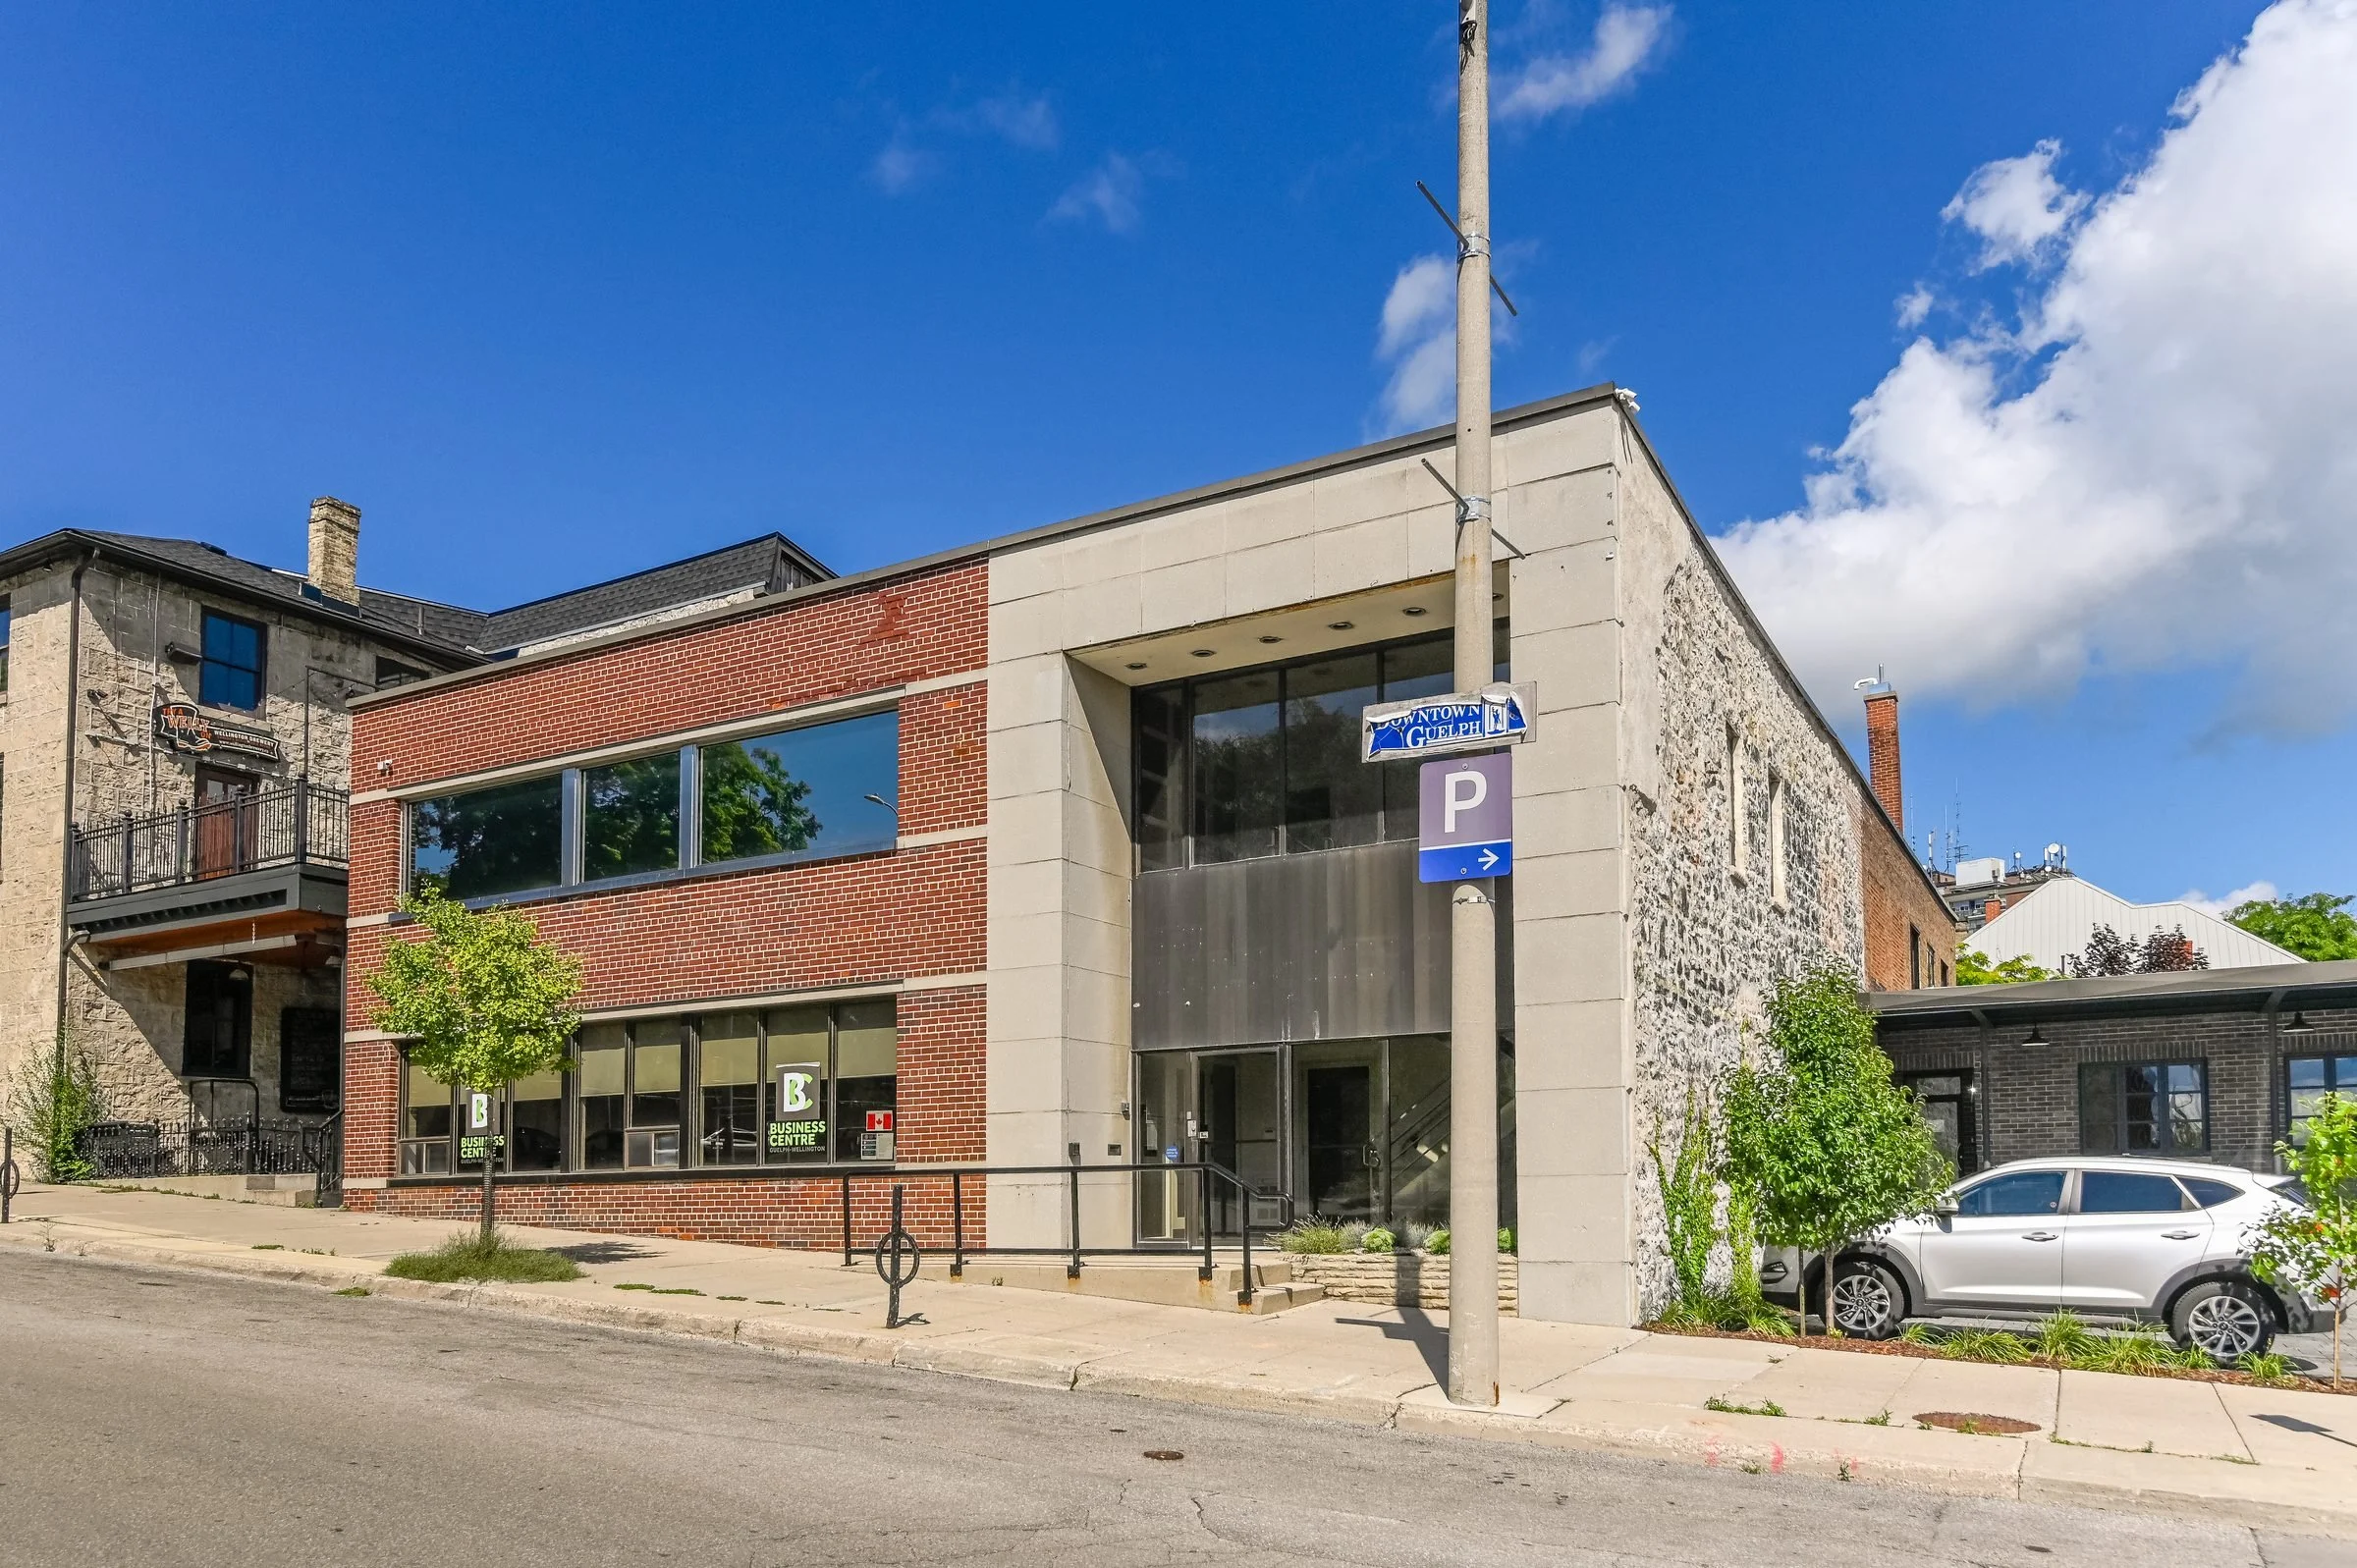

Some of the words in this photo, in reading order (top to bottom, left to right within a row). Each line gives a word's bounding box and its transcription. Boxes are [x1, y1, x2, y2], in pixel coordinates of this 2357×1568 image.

[179, 707, 184, 716] A
[167, 715, 210, 732] WELLY
[200, 730, 212, 739] ON
[214, 730, 247, 740] WELLINGTON
[248, 735, 274, 747] BREWERY
[1406, 721, 1481, 748] GUELPH
[1445, 771, 1487, 834] P
[769, 1121, 826, 1135] BUSINESS
[461, 1135, 505, 1148] BUSINSS
[769, 1134, 816, 1147] CENTRE
